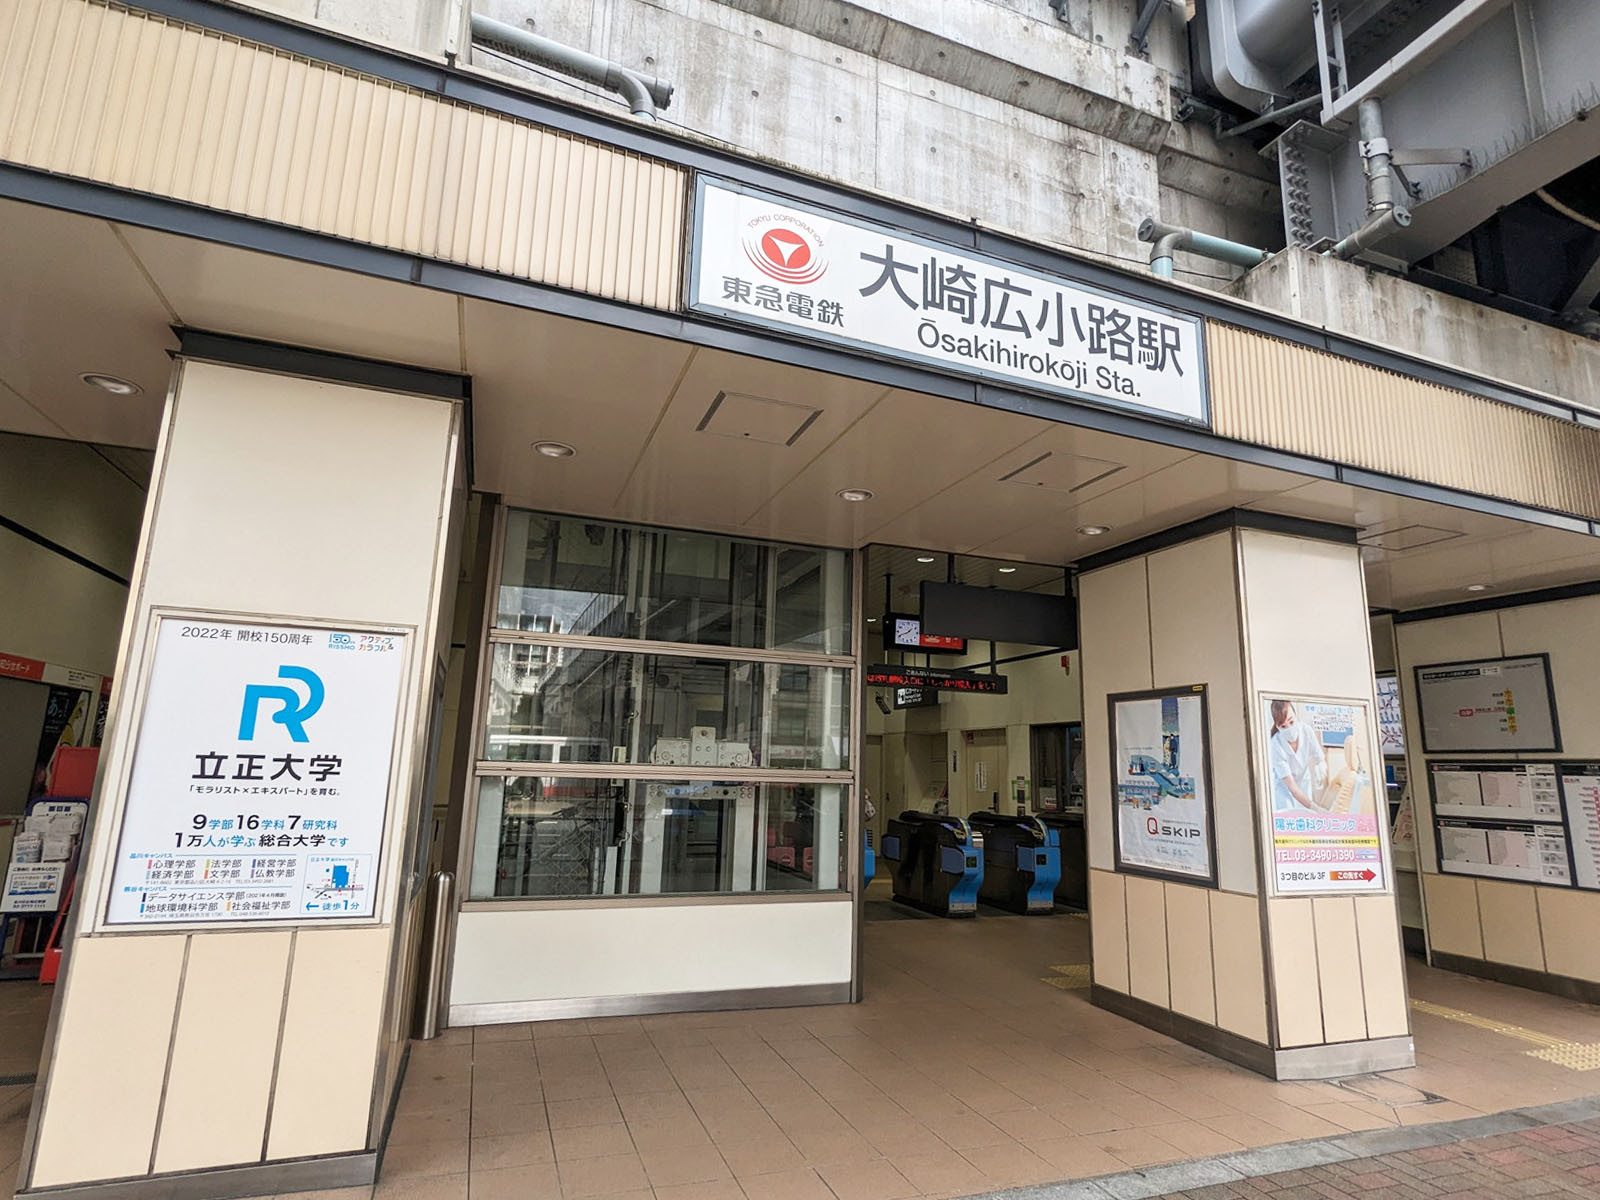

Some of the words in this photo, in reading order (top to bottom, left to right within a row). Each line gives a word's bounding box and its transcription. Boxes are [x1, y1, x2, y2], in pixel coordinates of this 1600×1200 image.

[747, 214, 771, 228] TOKYU
[774, 213, 824, 247] CORPORATION
[722, 275, 844, 328] 東急電鉄
[858, 244, 1184, 377] 大崎広小路駅
[917, 317, 1088, 389] Ōsakihirokōji
[1096, 365, 1142, 397] Sta.
[181, 626, 232, 640] 2022年
[237, 630, 313, 645] 開校150周年
[192, 751, 342, 782] 立正大学
[189, 784, 341, 796] 「モラリスト×エキスパート」を育む。
[1275, 817, 1356, 831] 陽光歯科クリニック
[1161, 826, 1201, 838] SKIP
[153, 859, 196, 869] 心理学部
[211, 859, 242, 868] 法学部
[257, 859, 297, 868] 経営学部
[151, 870, 194, 879] 経済学部
[210, 869, 241, 879] 文学部
[255, 869, 295, 878] 仏教学部
[148, 891, 245, 901] データサイエンス学部
[145, 902, 218, 912] 地球環境科学部
[231, 901, 291, 911] 社会福祉学部
[322, 900, 360, 911] 徒歩1分
